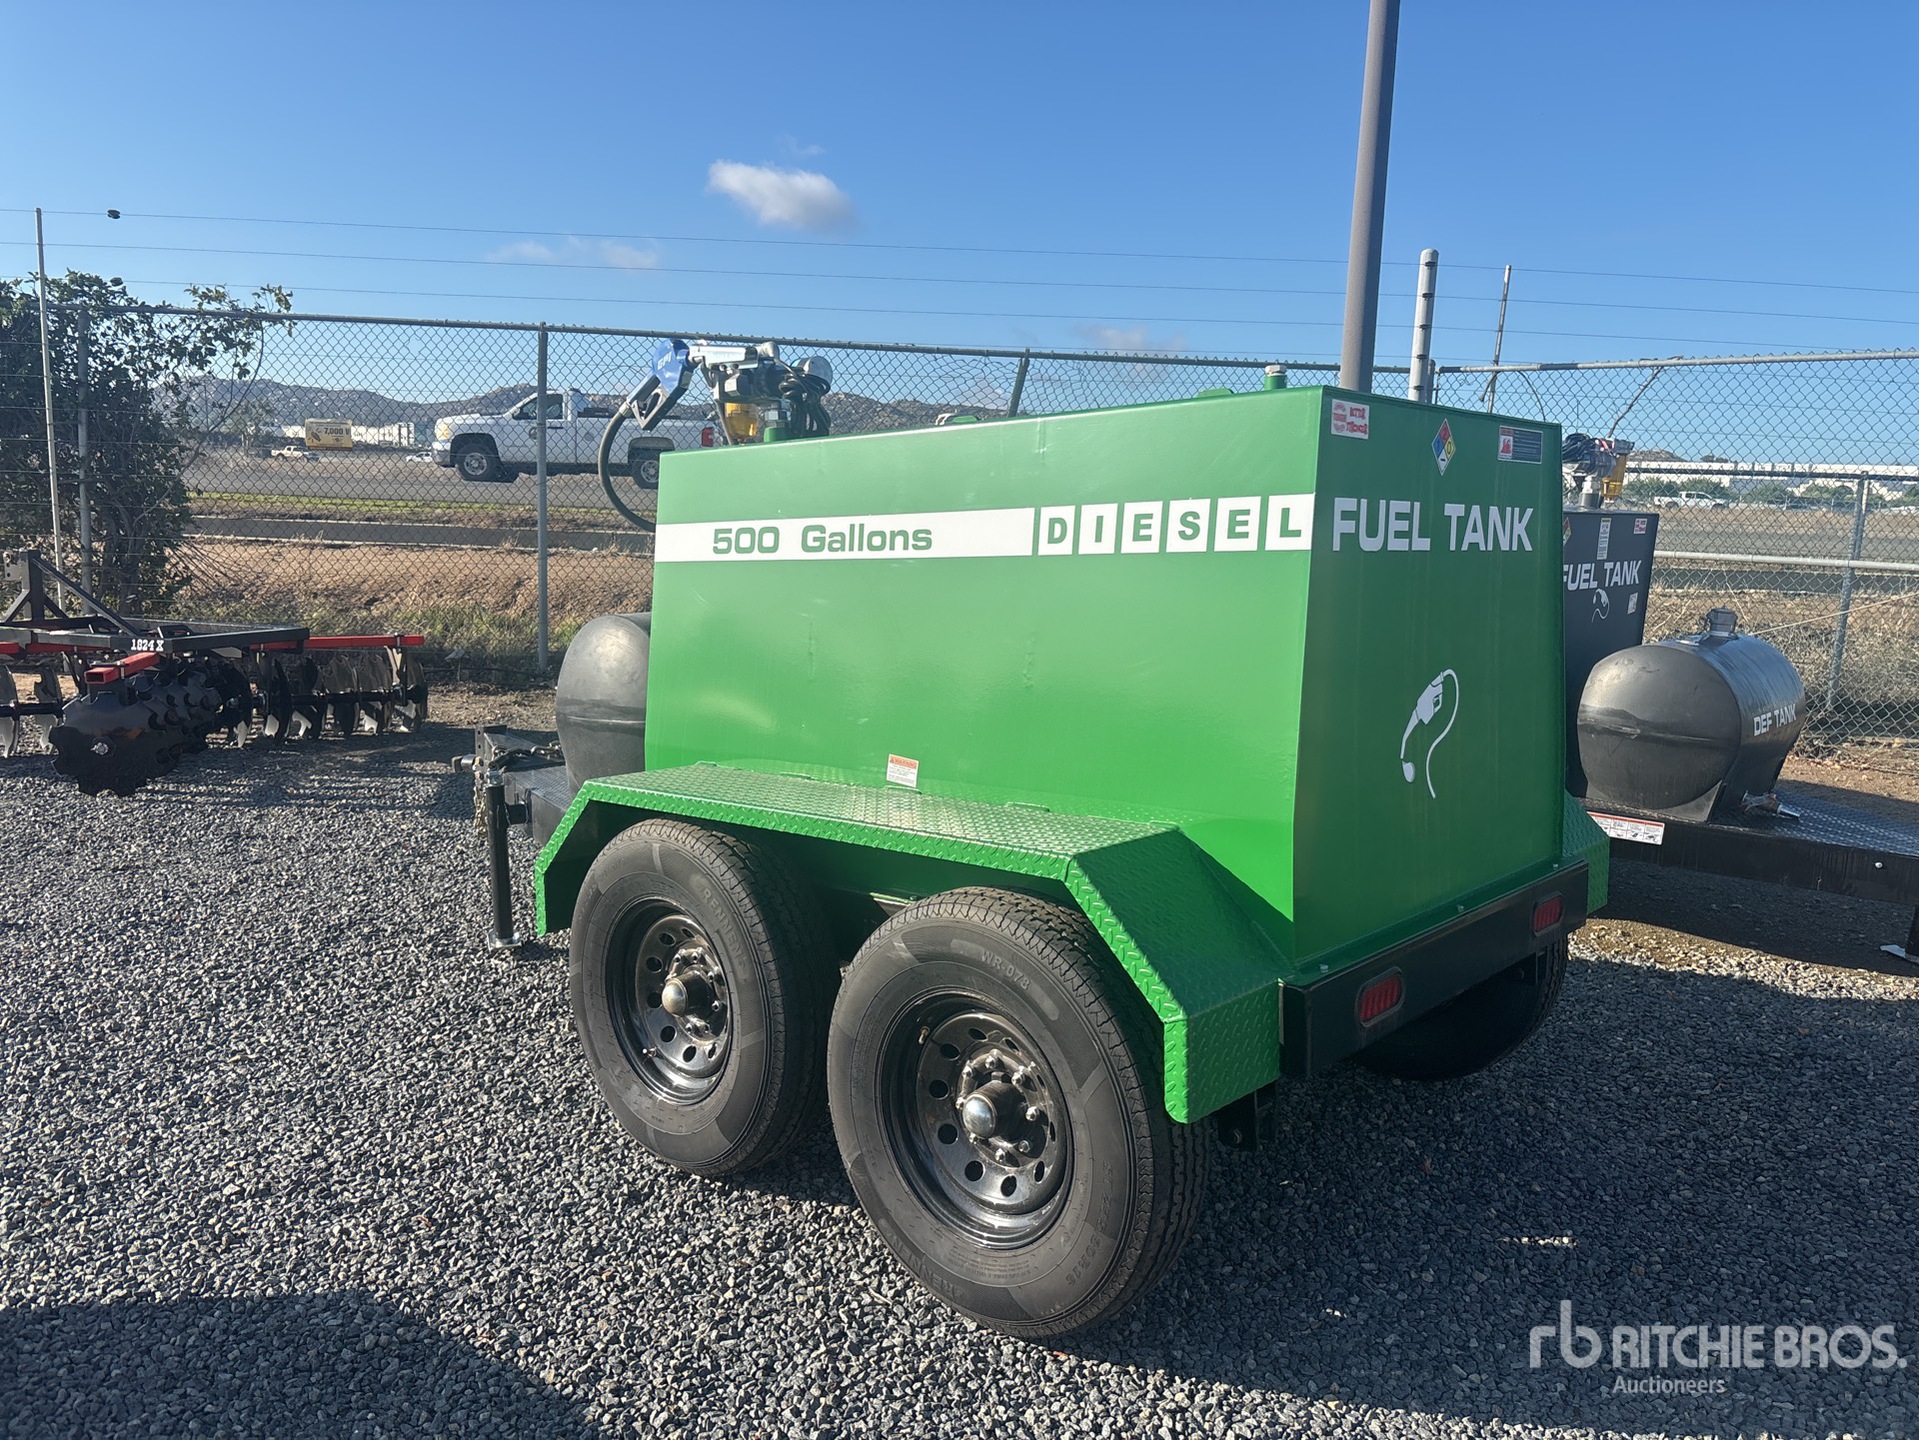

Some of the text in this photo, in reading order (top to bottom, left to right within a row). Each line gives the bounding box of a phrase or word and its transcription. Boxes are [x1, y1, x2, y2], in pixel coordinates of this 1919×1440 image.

[713, 523, 933, 555] 500 Gallons
[1047, 507, 1302, 544] DIESEL
[1332, 497, 1534, 551] FUEL TANK
[1604, 560, 1642, 587] TANK
[130, 638, 155, 651] 1824
[1753, 703, 1797, 737] DEF TANK
[981, 949, 1032, 990] WR-078
